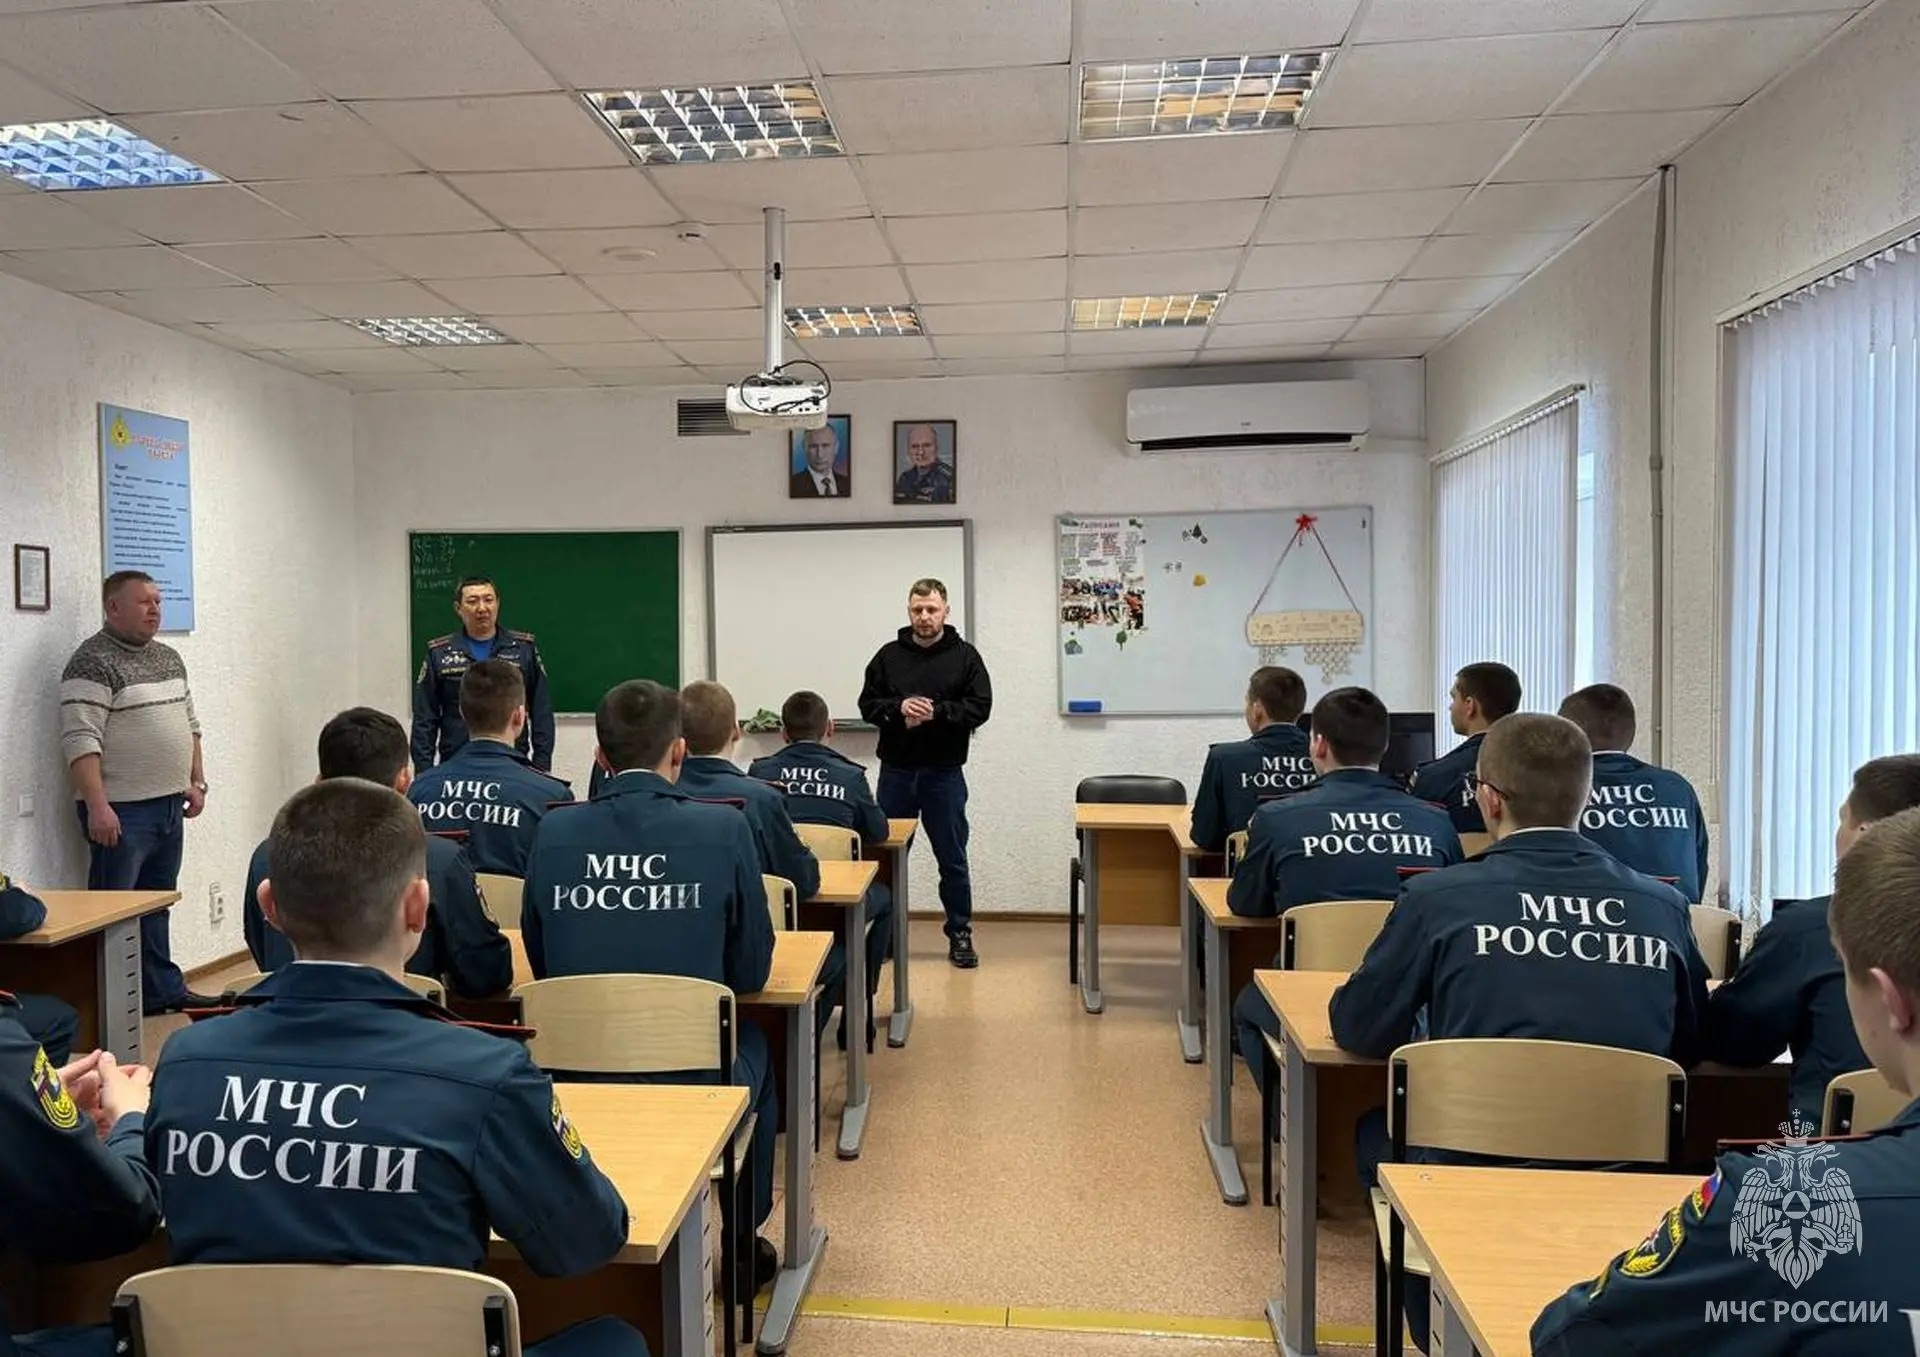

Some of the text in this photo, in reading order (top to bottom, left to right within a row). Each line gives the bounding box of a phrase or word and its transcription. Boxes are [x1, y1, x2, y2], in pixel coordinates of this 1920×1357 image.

[780, 767, 828, 782] МЧС
[1262, 756, 1312, 772] МЧС
[441, 780, 500, 800] МЧС
[787, 781, 845, 800] ССИИ
[1241, 772, 1317, 789] РОССИ
[1588, 784, 1656, 805] МЧС
[1330, 812, 1402, 831] МЧС
[1583, 807, 1689, 829] ОССИИ
[1302, 833, 1433, 857] РОССИИ
[585, 853, 667, 880] МЧС
[553, 883, 702, 911] РОССИИ
[1518, 892, 1626, 926] МЧС
[1473, 924, 1668, 971] РОССИИ
[216, 1075, 366, 1129] МЧС
[165, 1129, 423, 1194] РОССИИ
